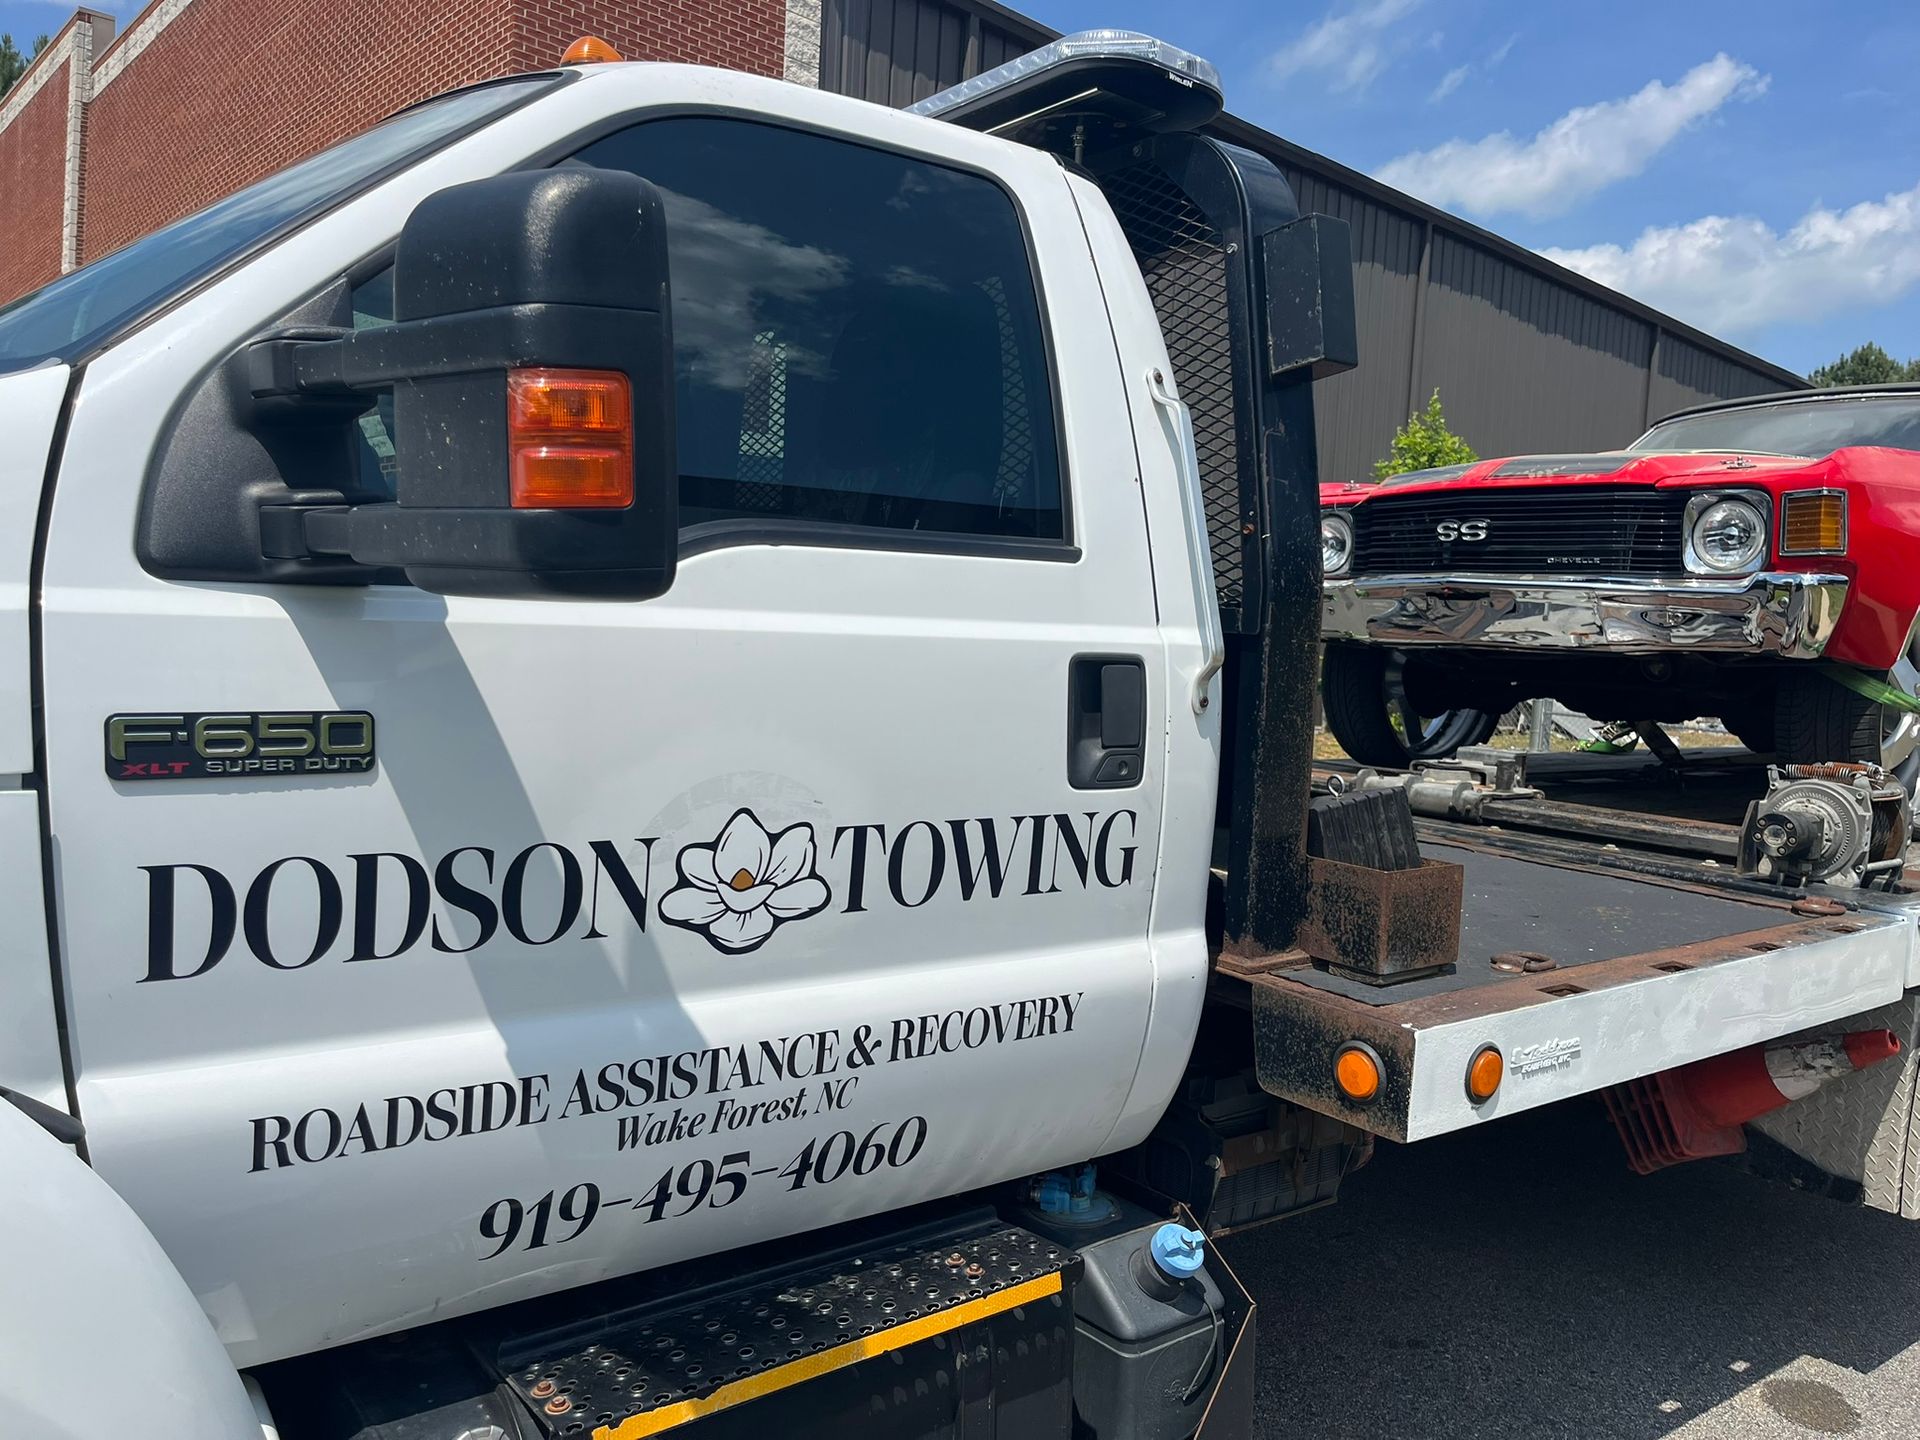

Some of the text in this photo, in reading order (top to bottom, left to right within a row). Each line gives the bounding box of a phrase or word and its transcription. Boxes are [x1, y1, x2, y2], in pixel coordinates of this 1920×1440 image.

[1436, 518, 1491, 542] SS
[1547, 556, 1600, 564] CHEVELLE
[109, 714, 373, 761] F-650
[119, 762, 190, 776] XLT
[204, 756, 373, 773] SUPER DUTY
[136, 809, 1138, 984] DODSON TOWING
[247, 992, 1085, 1174] ROADSIDE ASSISTANCE & RECOVERY
[617, 1076, 859, 1152] Wake Forest, NC
[477, 1115, 928, 1261] 919-495-4060
